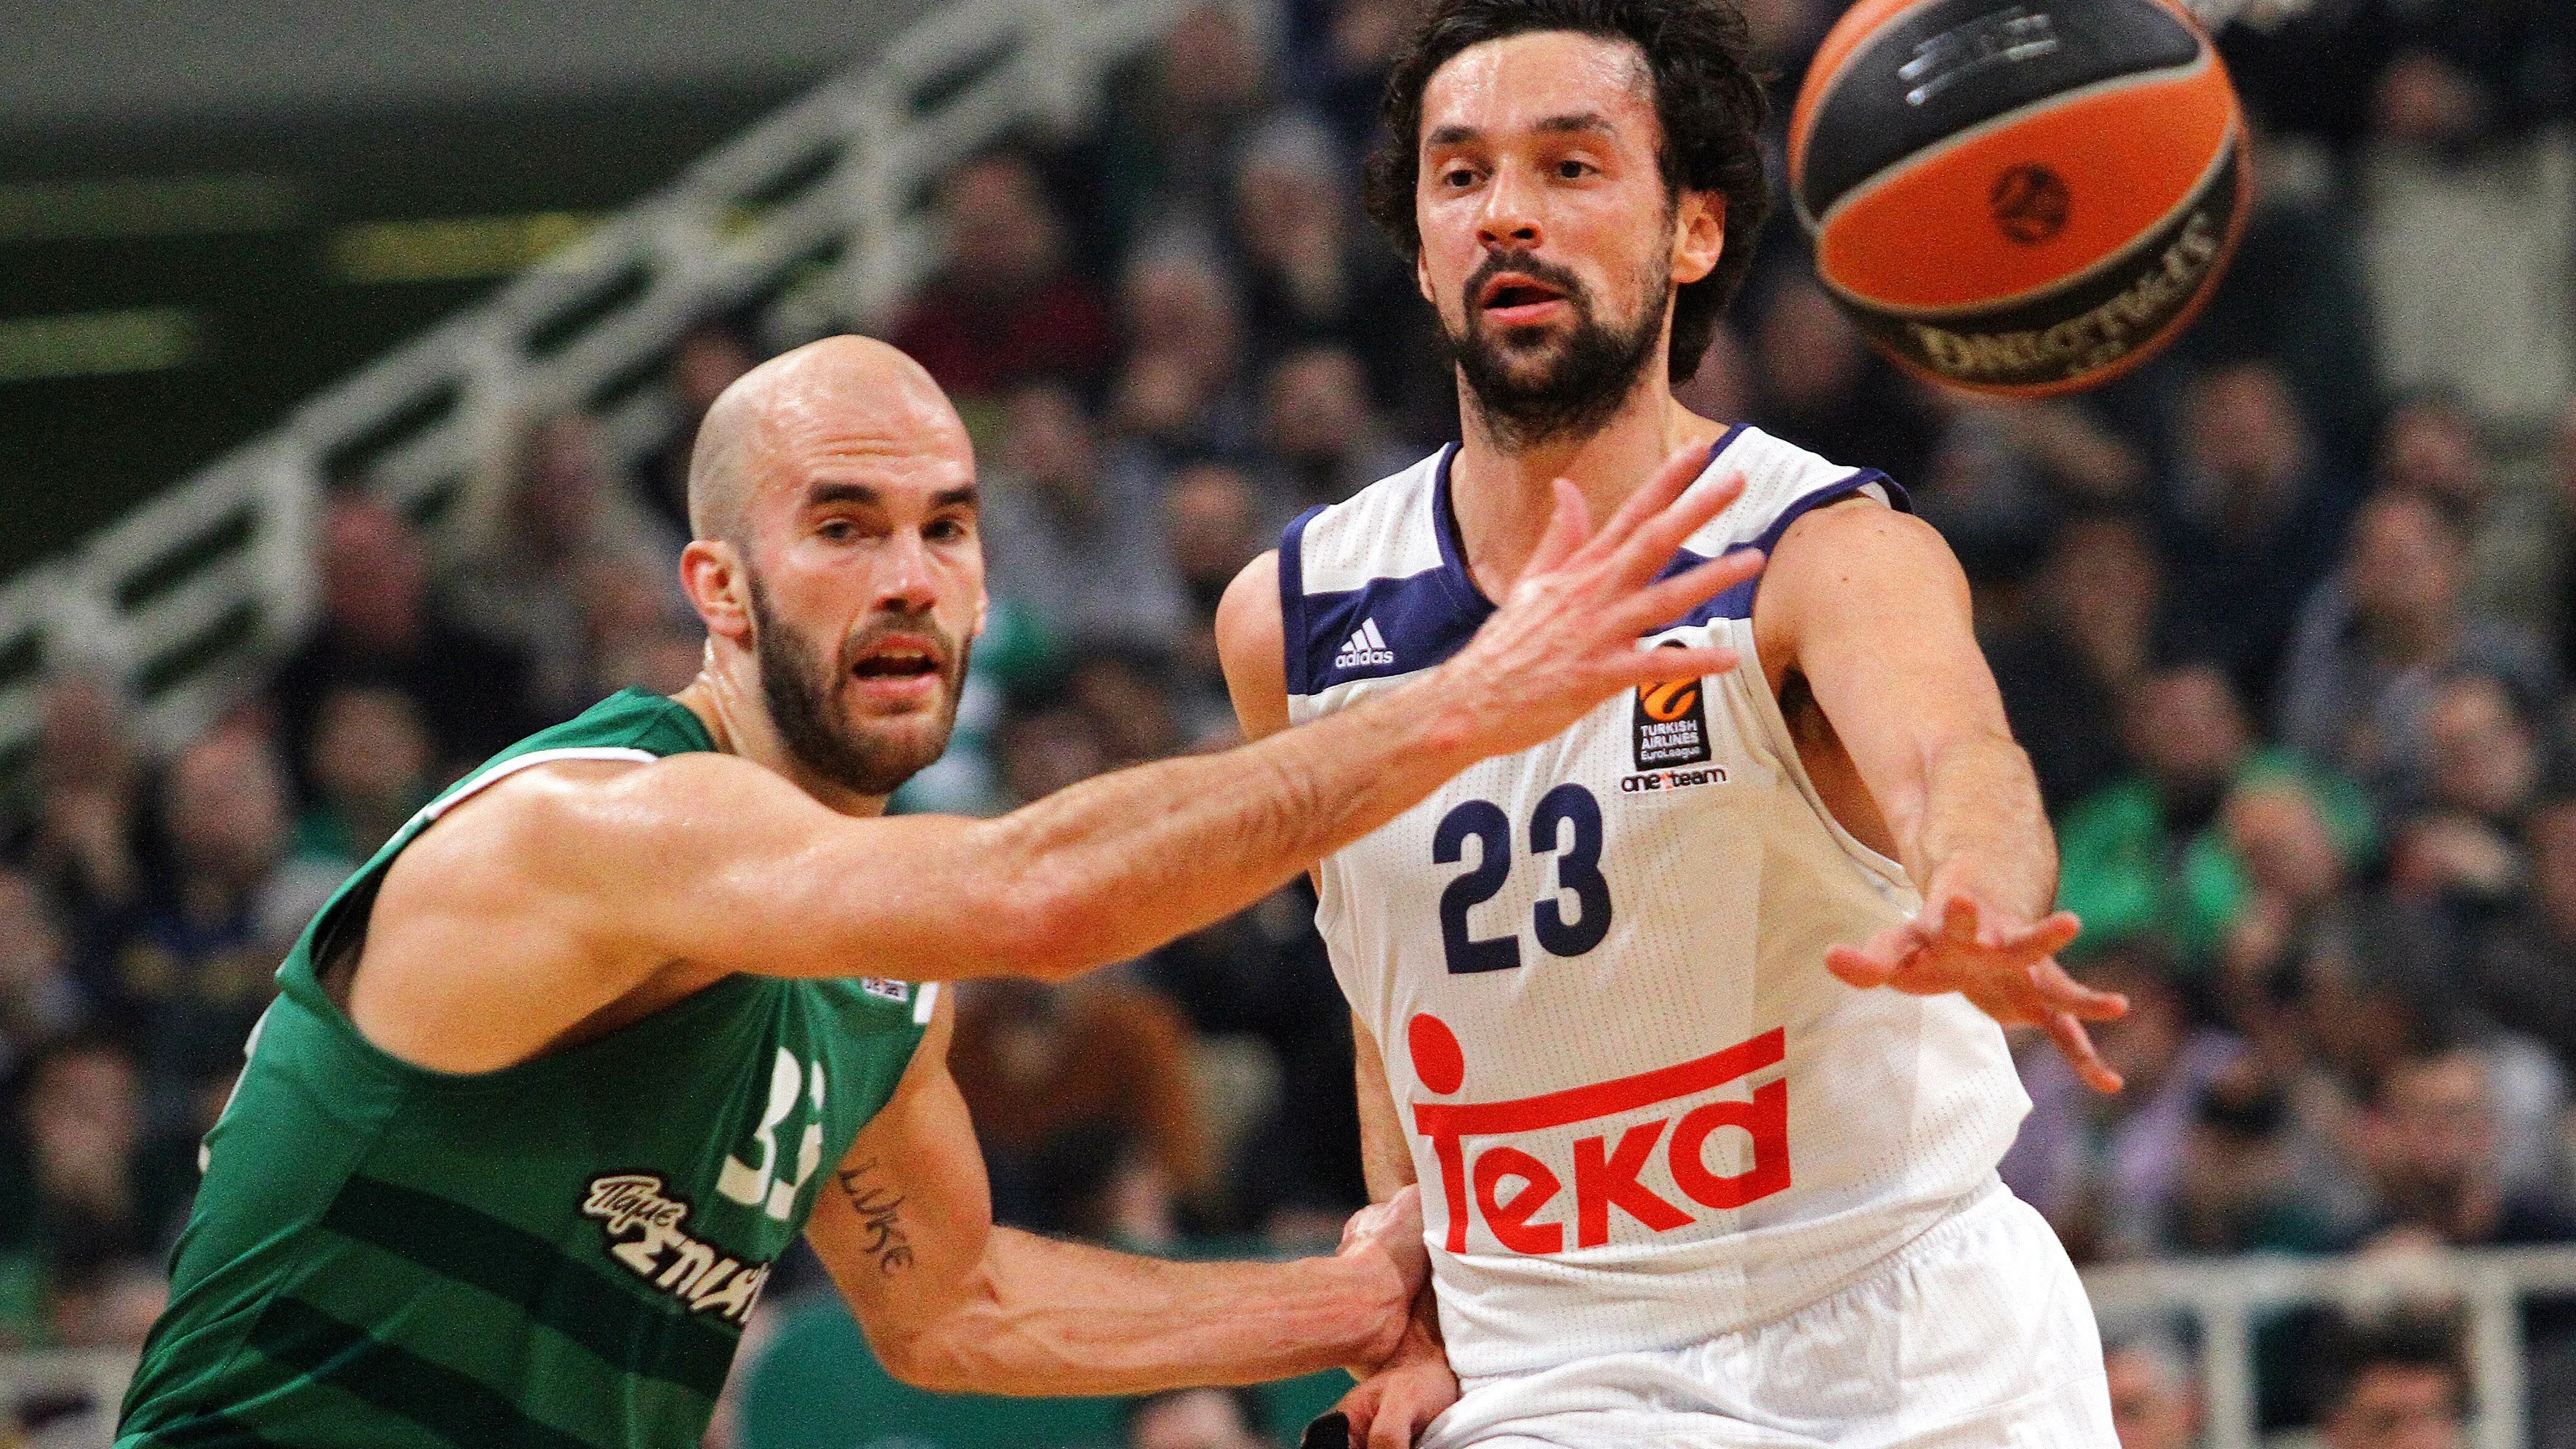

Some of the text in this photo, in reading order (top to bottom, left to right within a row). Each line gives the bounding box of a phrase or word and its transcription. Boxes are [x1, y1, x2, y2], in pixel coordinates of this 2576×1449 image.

[1906, 212, 2218, 371] SPALDING
[1336, 648, 1394, 668] adidas
[1640, 719, 1698, 737] TURKISH
[1642, 731, 1700, 750] AIRLINES
[1432, 782, 1613, 975] 23
[1411, 1016, 1791, 1255] Teka
